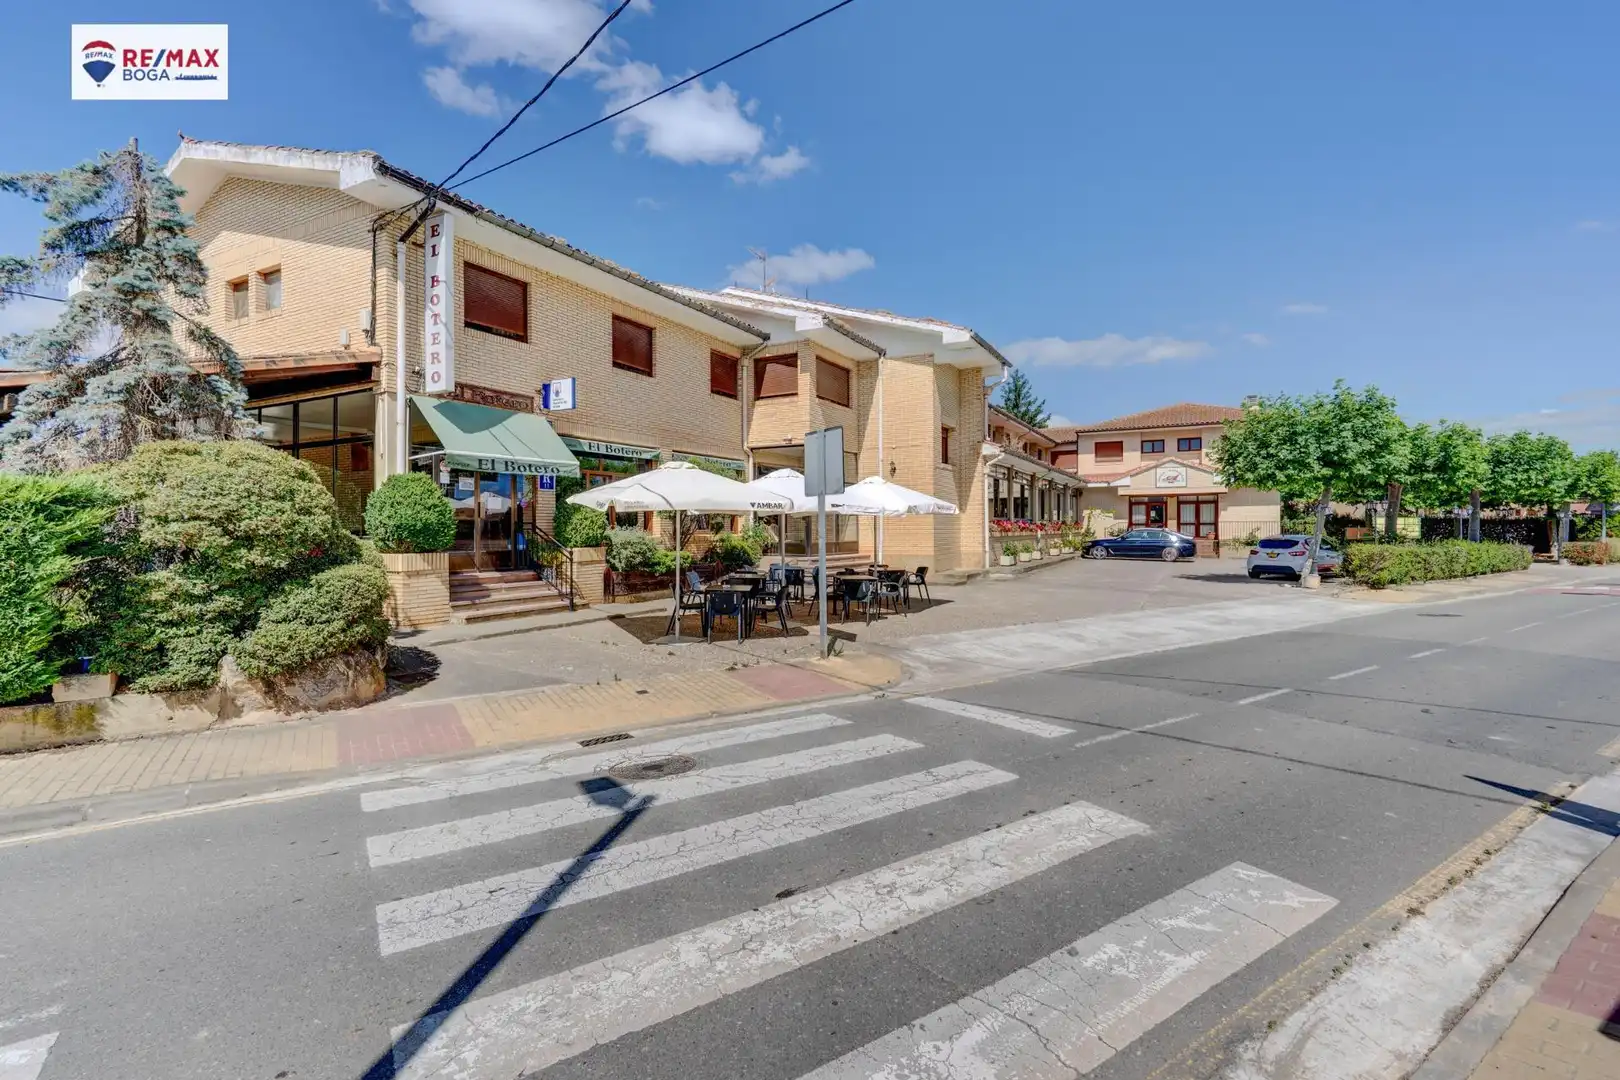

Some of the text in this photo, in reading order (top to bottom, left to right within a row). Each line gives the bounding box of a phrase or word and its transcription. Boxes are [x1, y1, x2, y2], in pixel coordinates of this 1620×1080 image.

[430, 224, 441, 384] EL BOTERO
[588, 442, 642, 456] El Botero
[477, 458, 496, 470] El
[504, 460, 560, 474] Botero
[757, 501, 783, 510] AMBAR
